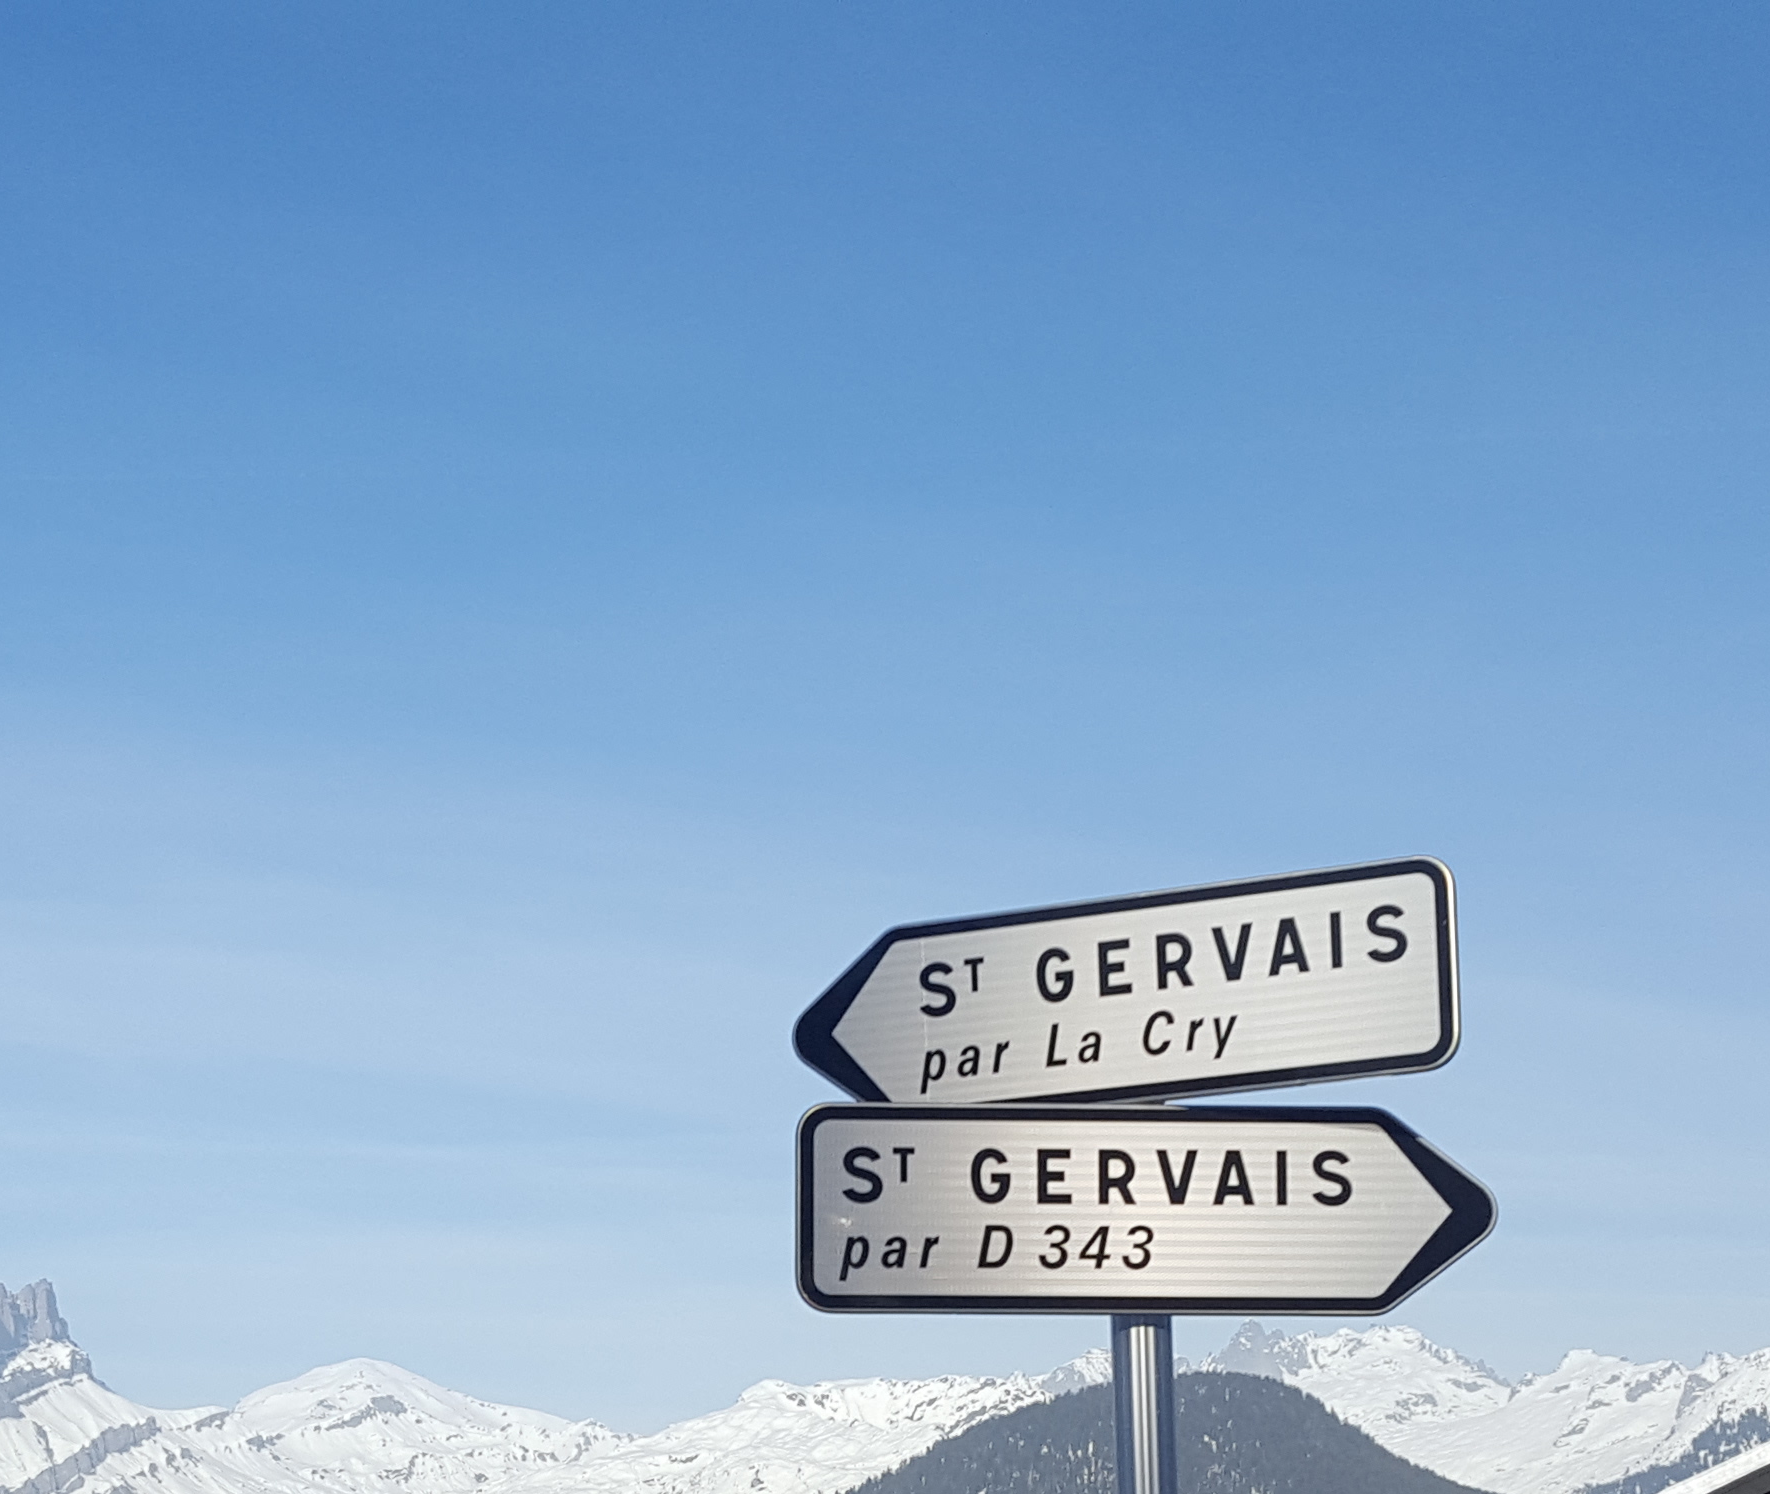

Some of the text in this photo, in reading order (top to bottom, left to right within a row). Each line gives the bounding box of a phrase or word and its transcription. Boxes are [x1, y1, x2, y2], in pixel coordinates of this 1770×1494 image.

[1036, 904, 1409, 1003] GERVAIS
[919, 1010, 1238, 1095] par La Cry
[969, 1147, 1353, 1207] GERVAIS
[838, 1224, 1155, 1282] par D 343
